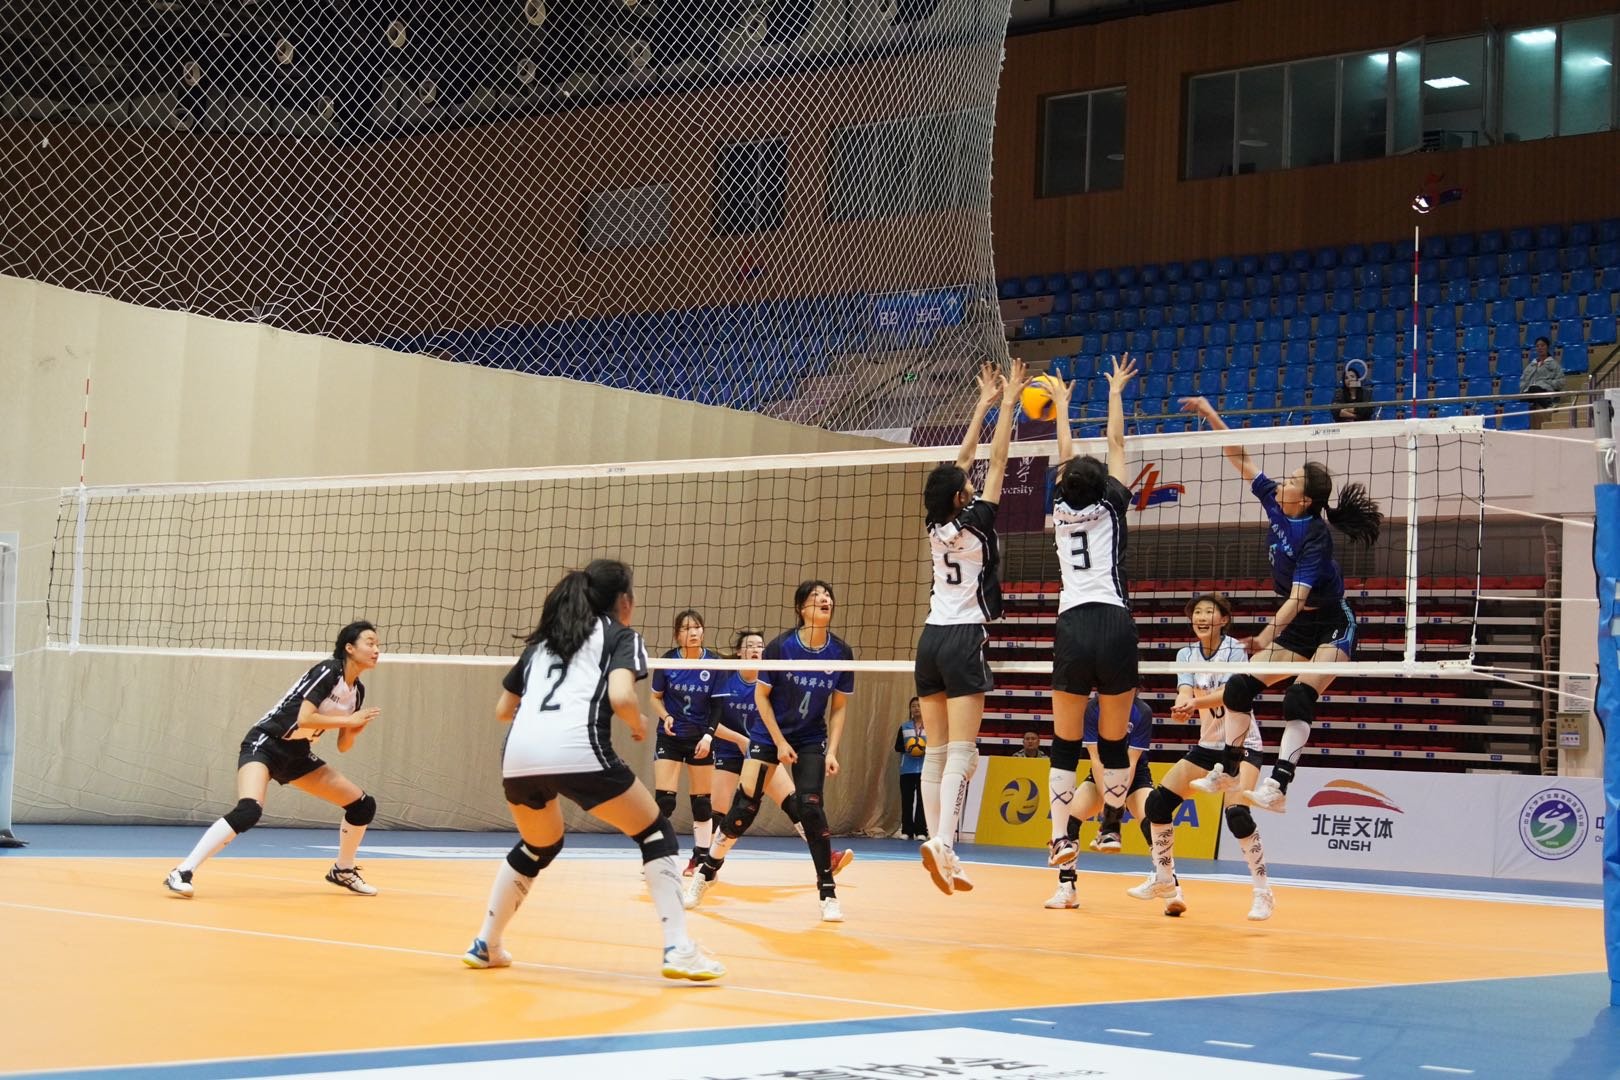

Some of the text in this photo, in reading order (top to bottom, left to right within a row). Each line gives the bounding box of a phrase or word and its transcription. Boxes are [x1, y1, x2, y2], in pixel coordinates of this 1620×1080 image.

[1071, 531, 1091, 570] 3
[943, 552, 962, 585] 5
[540, 663, 568, 712] 2
[683, 695, 692, 716] 2
[798, 691, 812, 720] 4
[1311, 813, 1394, 839] 北岸文体
[1328, 839, 1371, 852] QNSH
